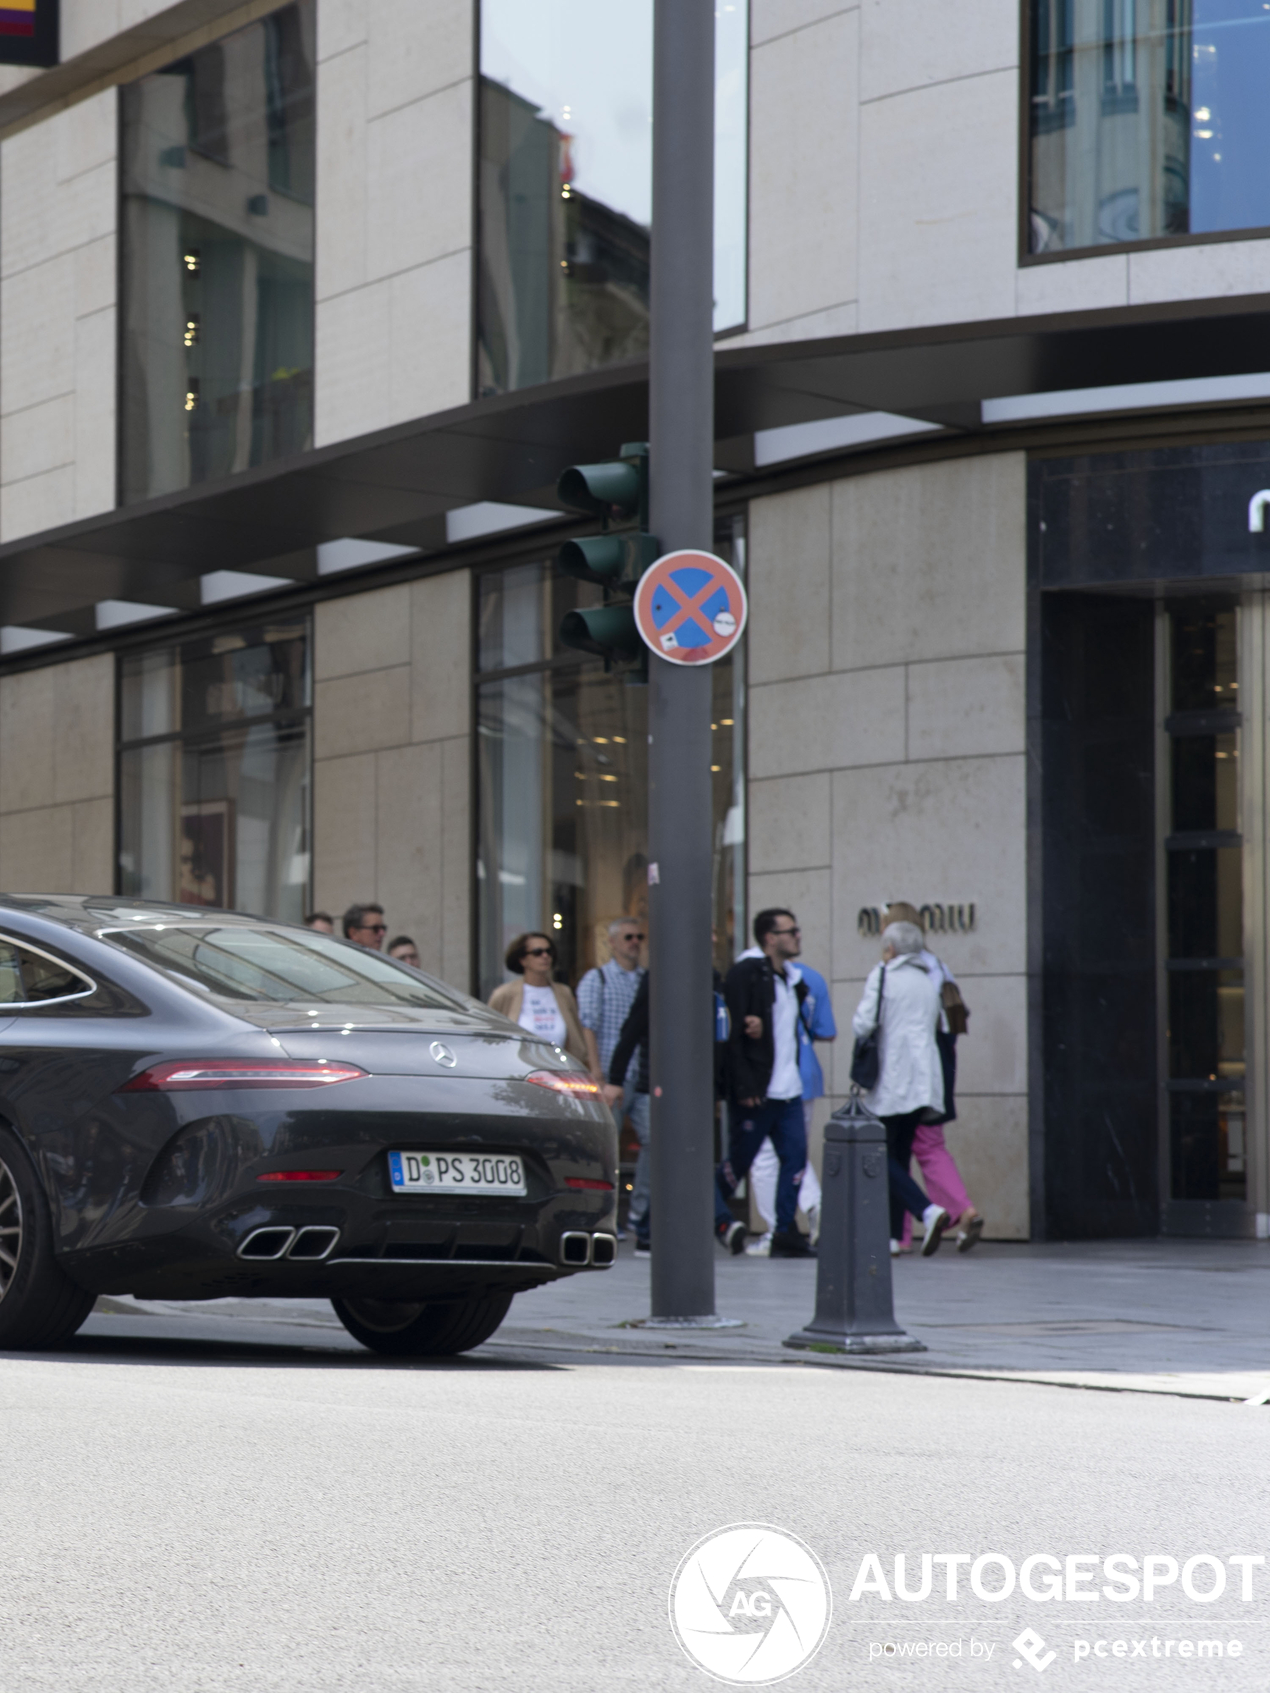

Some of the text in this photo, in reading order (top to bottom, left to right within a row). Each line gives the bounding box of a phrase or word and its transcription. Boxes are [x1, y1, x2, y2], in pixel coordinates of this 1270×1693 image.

[406, 1156, 521, 1185] D PS 3008
